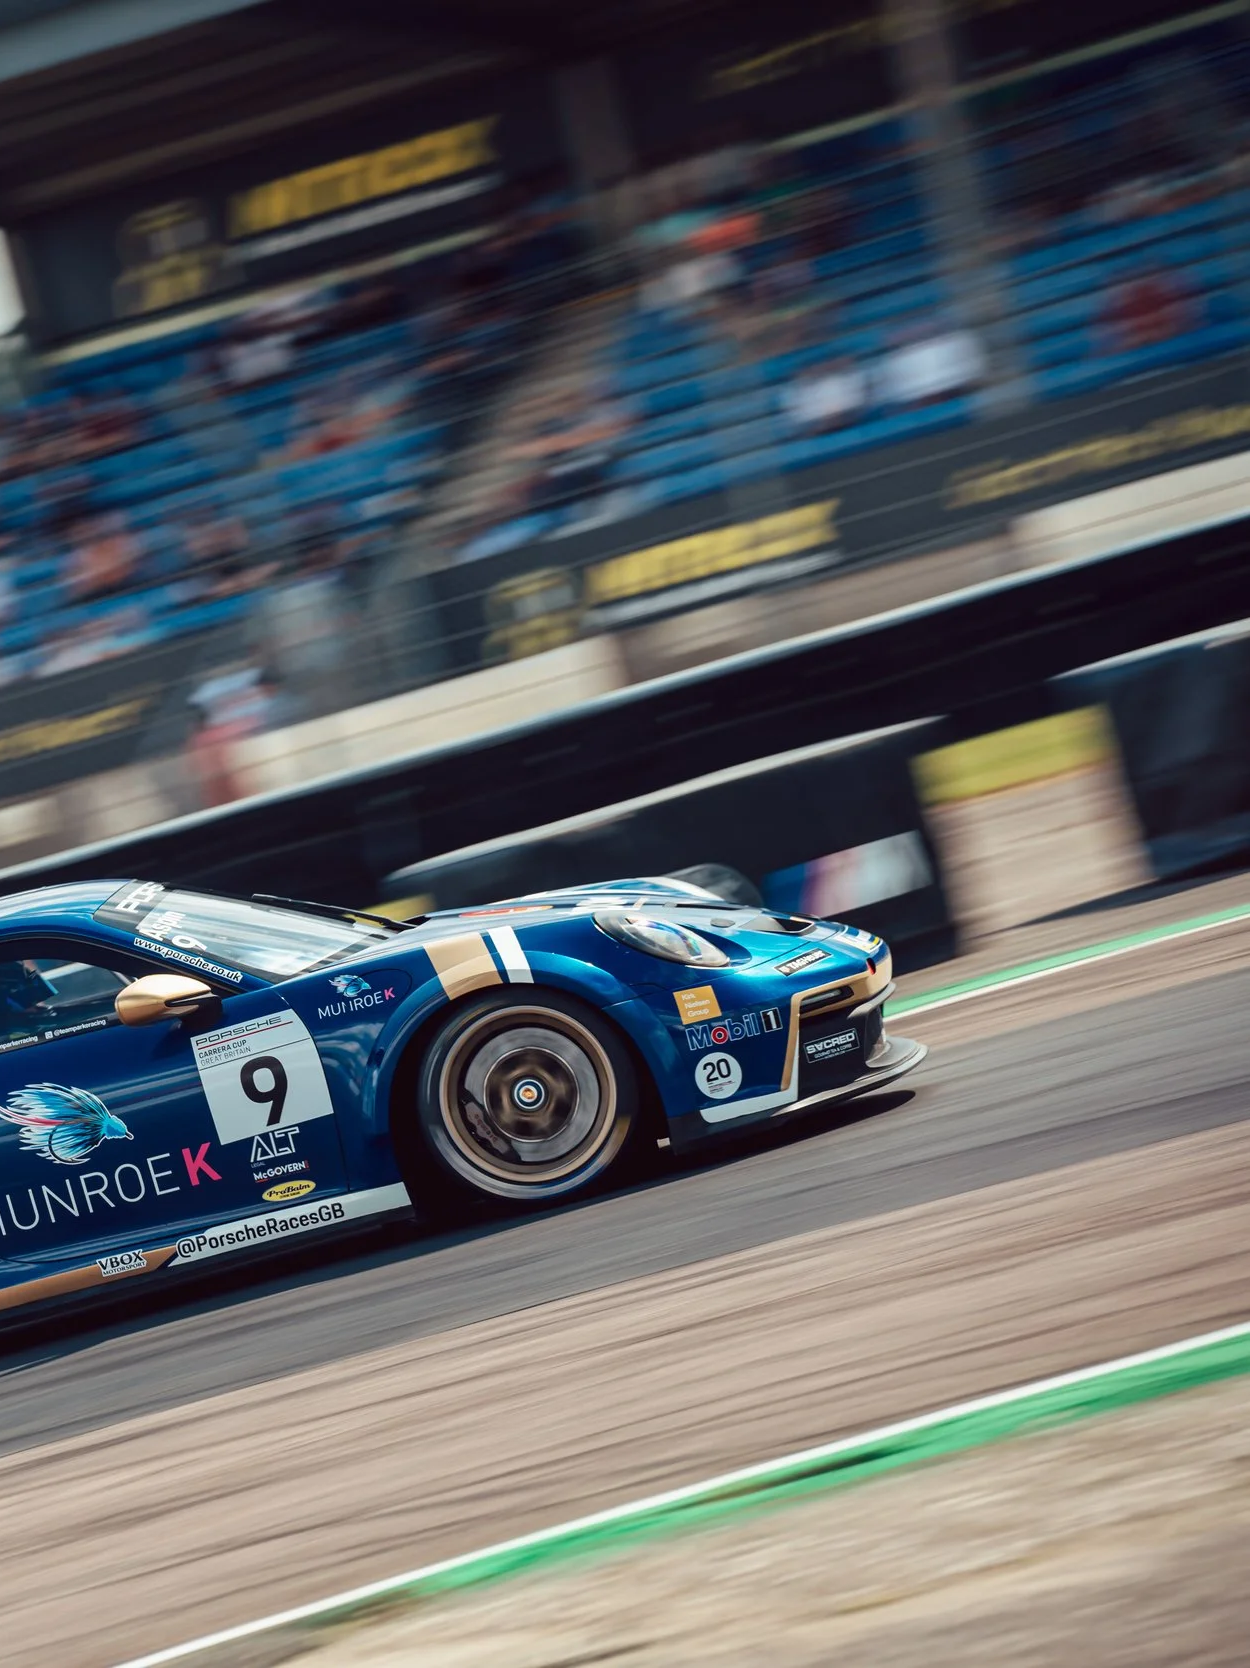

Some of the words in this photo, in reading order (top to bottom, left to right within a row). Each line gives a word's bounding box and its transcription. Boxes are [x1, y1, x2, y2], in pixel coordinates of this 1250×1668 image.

[134, 938, 241, 982] www.porsche.co.uk
[687, 1008, 710, 1018] Group
[195, 1016, 282, 1047] PORSCHE
[685, 1012, 760, 1051] Mobil
[198, 1044, 231, 1059] CARRERA
[232, 1039, 248, 1050] CUP
[200, 1055, 223, 1067] GREAT
[223, 1046, 252, 1060] BRITAIN
[702, 1058, 732, 1083] 20
[240, 1055, 288, 1127] 9
[250, 1126, 300, 1163] ALT
[253, 1160, 306, 1181] McGOVERN
[177, 1202, 346, 1258] @PorscheRacesGB
[97, 1249, 144, 1271] VBOX
[102, 1260, 146, 1276] MOTORSPORT
